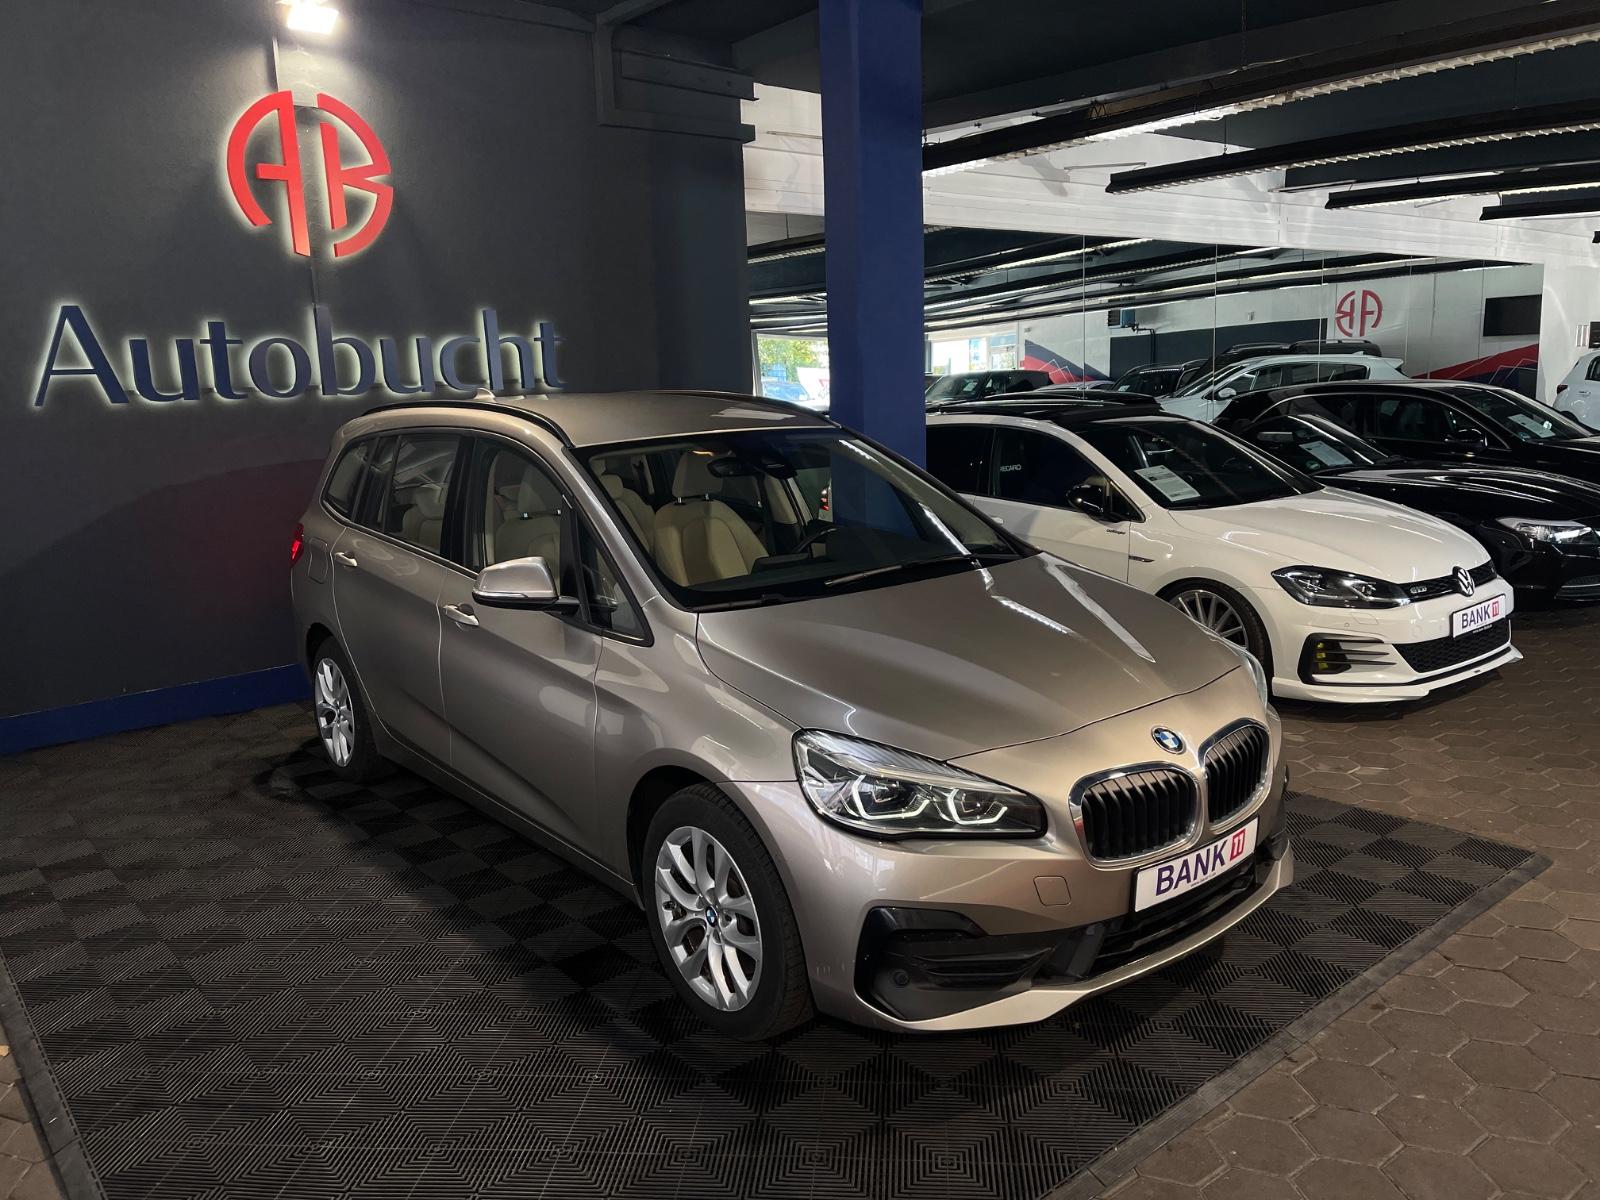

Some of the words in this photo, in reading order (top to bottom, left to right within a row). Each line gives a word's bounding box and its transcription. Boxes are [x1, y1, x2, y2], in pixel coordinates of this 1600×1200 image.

[34, 304, 567, 407] Autobucht
[1461, 604, 1490, 629] BANK
[1156, 840, 1227, 896] BANK
